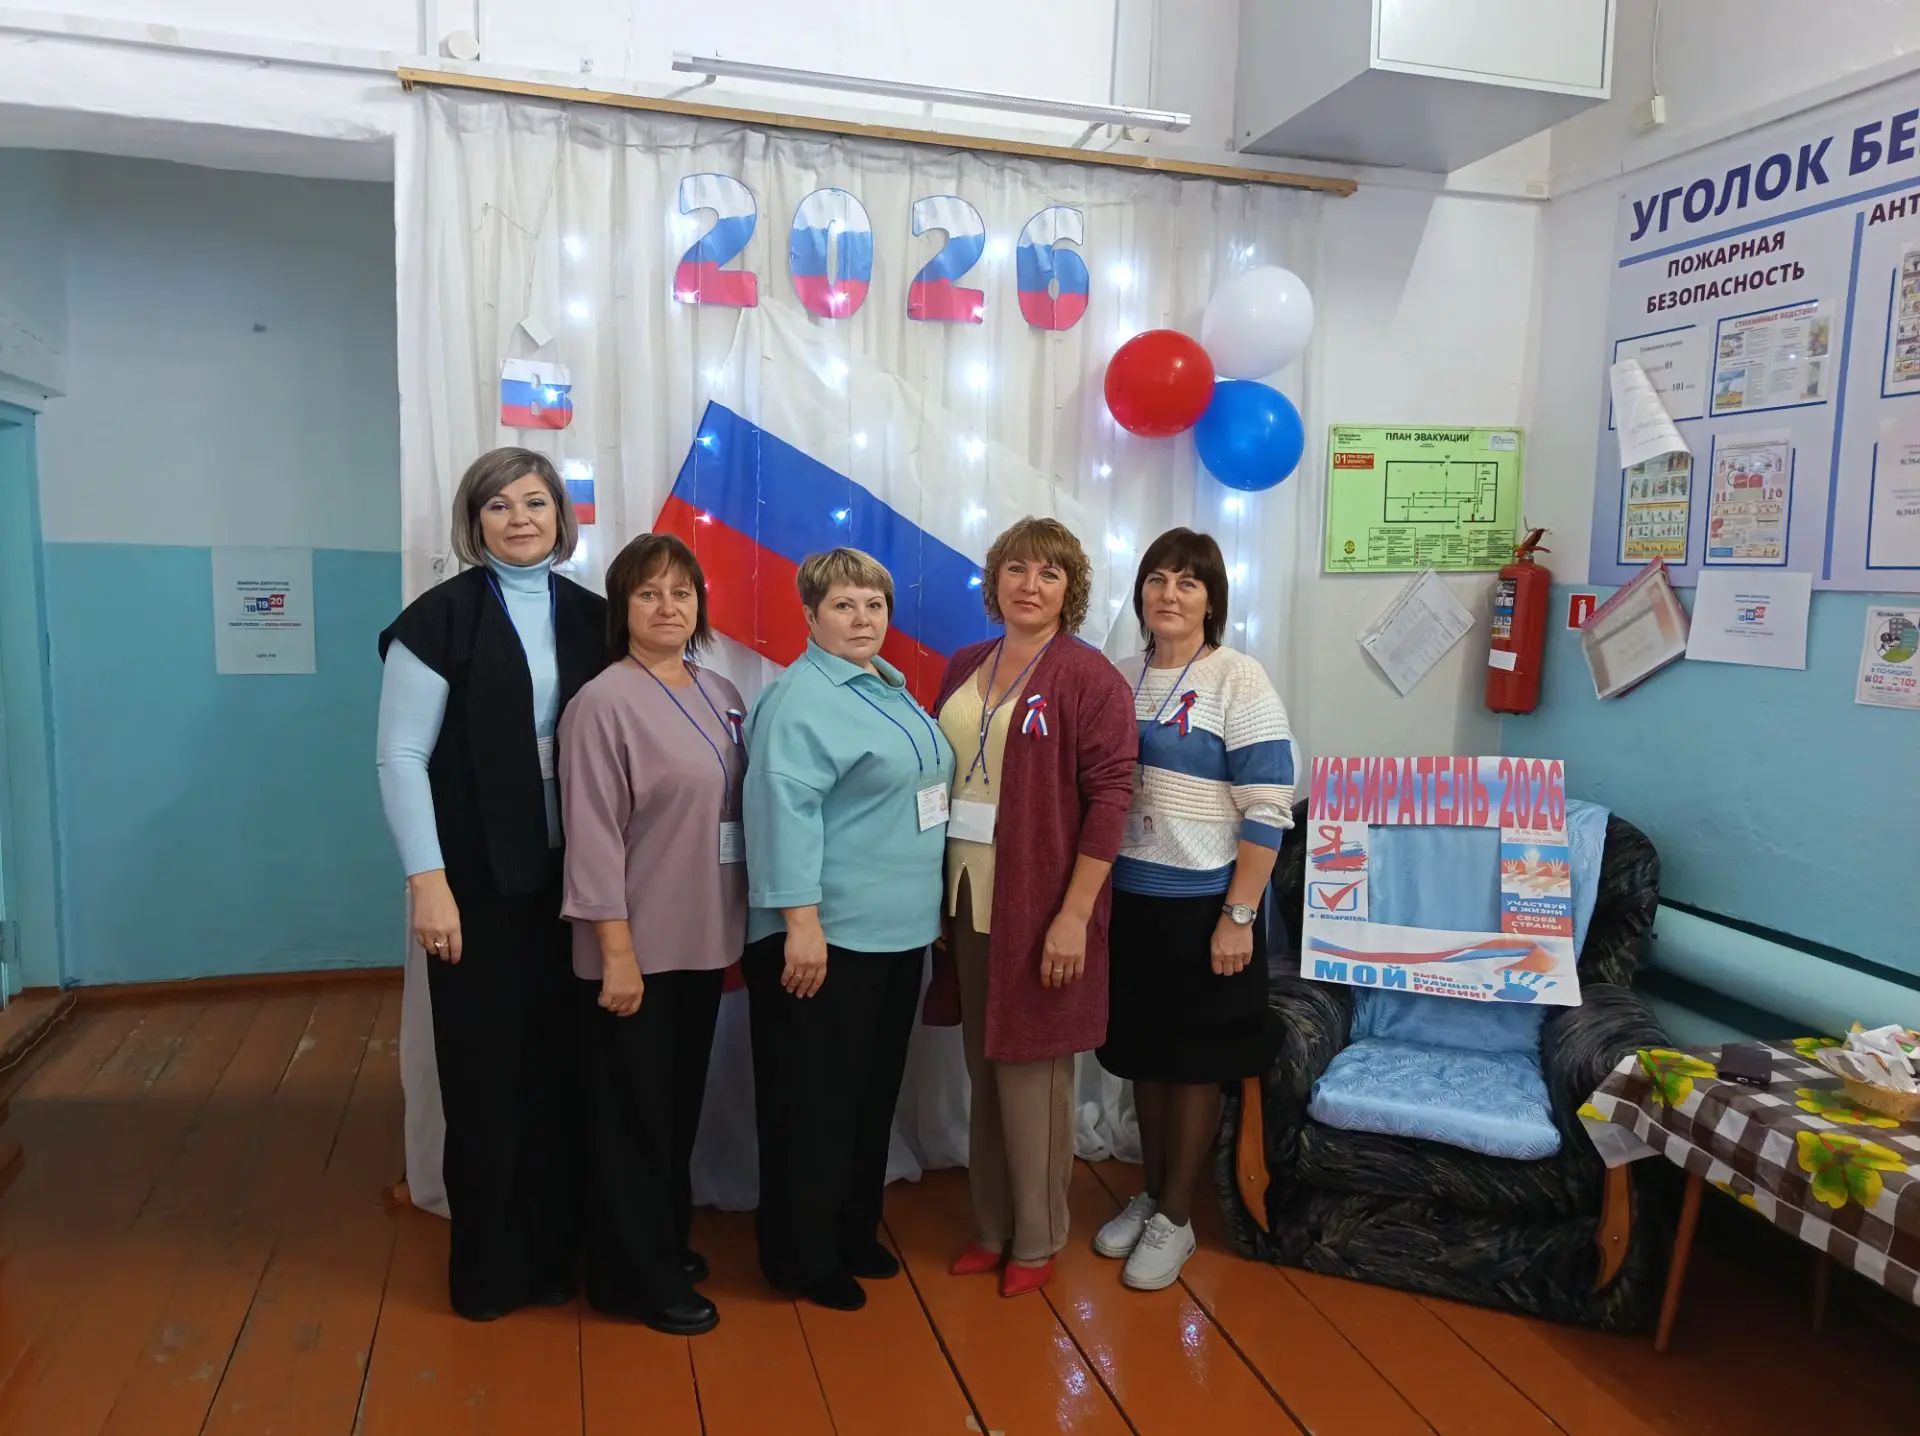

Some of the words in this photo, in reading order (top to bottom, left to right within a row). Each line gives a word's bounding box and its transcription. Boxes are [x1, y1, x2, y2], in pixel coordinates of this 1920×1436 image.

[1630, 136, 1834, 242] УГОЛОК
[673, 172, 1090, 331] 2026
[1667, 231, 1786, 279] ПОЖАРНАЯ
[1646, 261, 1805, 314] БЕЗОПАСНОСТЬ
[1385, 432, 1412, 441] ПЛАН
[1413, 433, 1470, 444] ЭВАКУАЦИИ
[1335, 454, 1347, 464] 01
[257, 601, 269, 609] 19
[1873, 675, 1884, 684] 02
[1901, 678, 1917, 687] 102
[1309, 756, 1489, 826] ИЗБИРАТЕЛЬ
[1500, 758, 1566, 831] 2026
[1507, 900, 1567, 910] УЧАСТВУЙ
[1520, 907, 1563, 916] ЖИЗНИ
[1516, 915, 1557, 924] СВОЕЙ
[1511, 921, 1562, 931] СТРАНЫ
[1314, 959, 1407, 989] МОЙ
